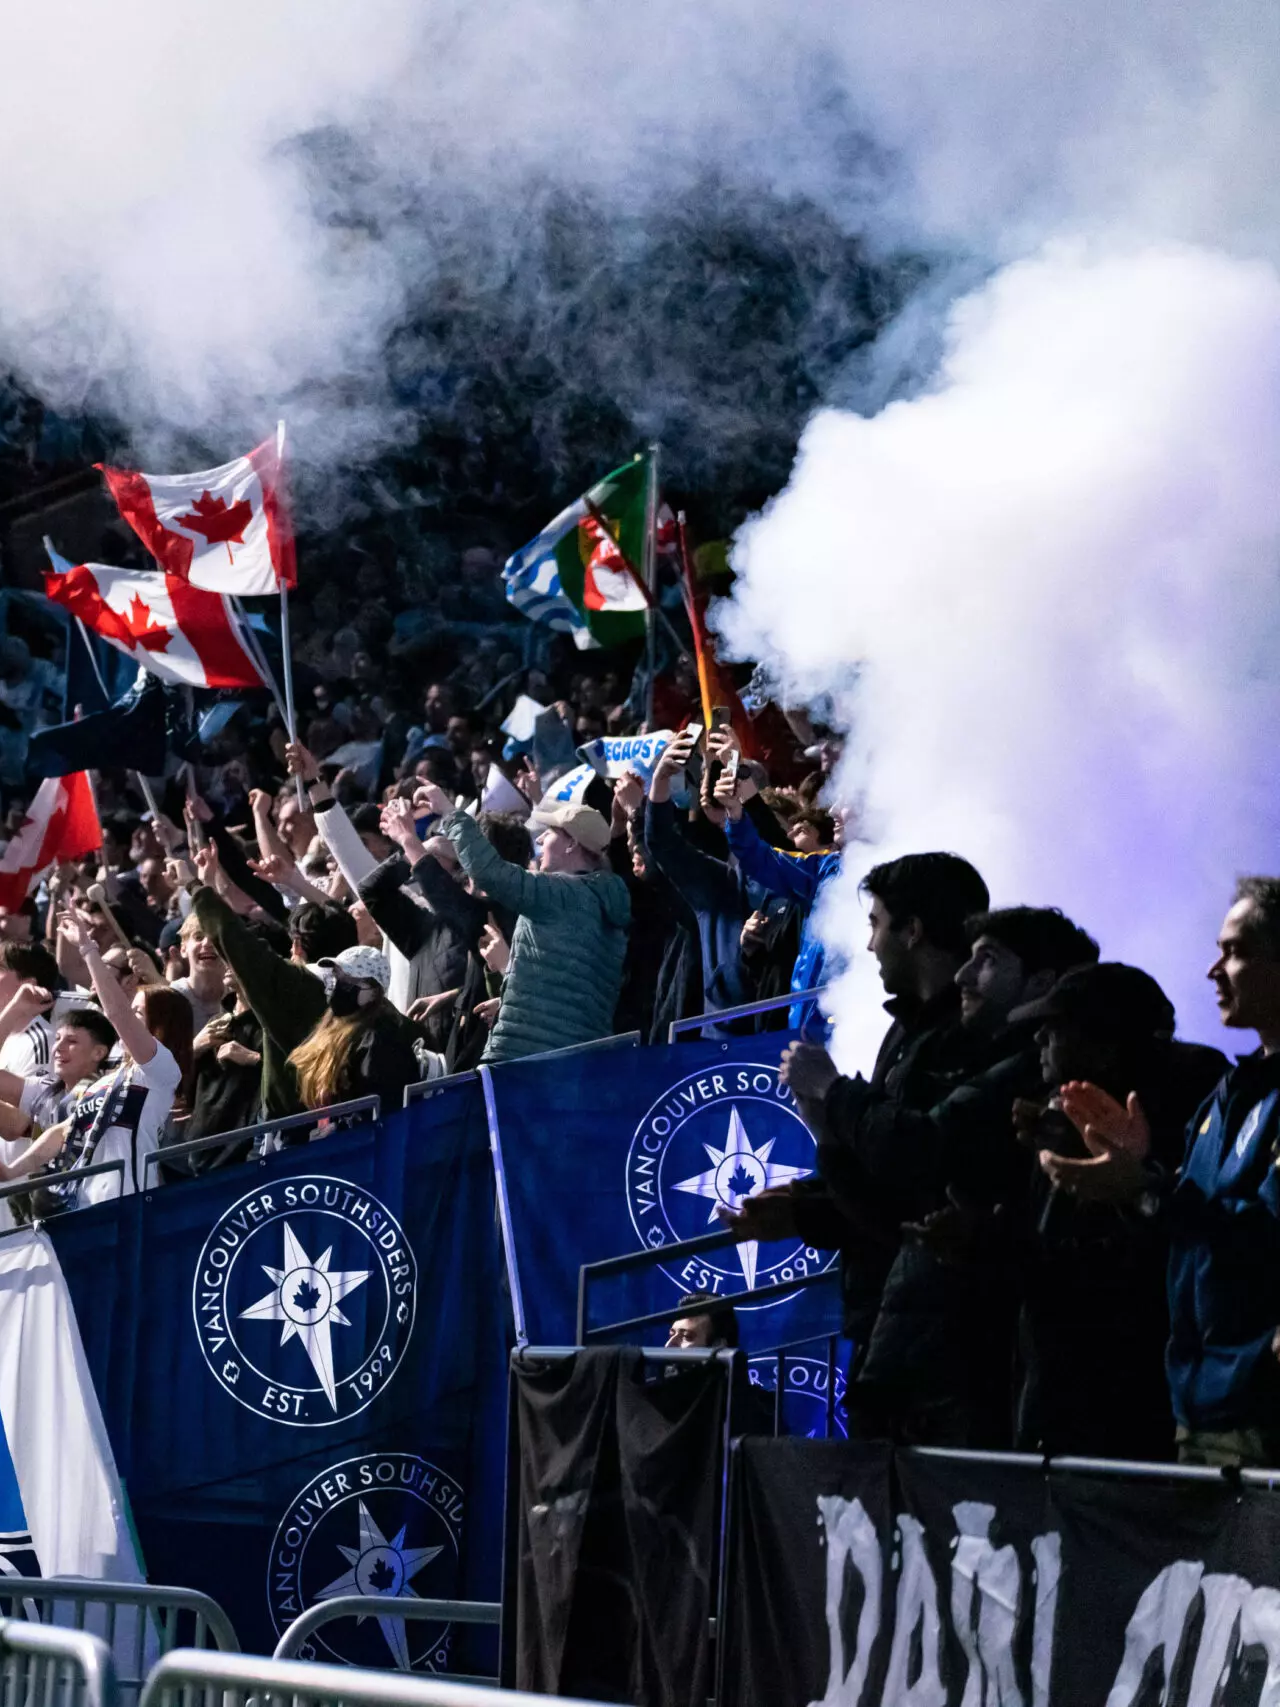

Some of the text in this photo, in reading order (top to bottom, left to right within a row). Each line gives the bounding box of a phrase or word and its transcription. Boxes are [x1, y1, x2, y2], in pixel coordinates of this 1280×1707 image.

[635, 1071, 798, 1215] VANCOUVER SOU
[201, 1184, 412, 1353] VANCOUVER SOUTHSIDERS
[770, 1246, 820, 1285] 1999
[261, 1345, 392, 1416] EST. 1999
